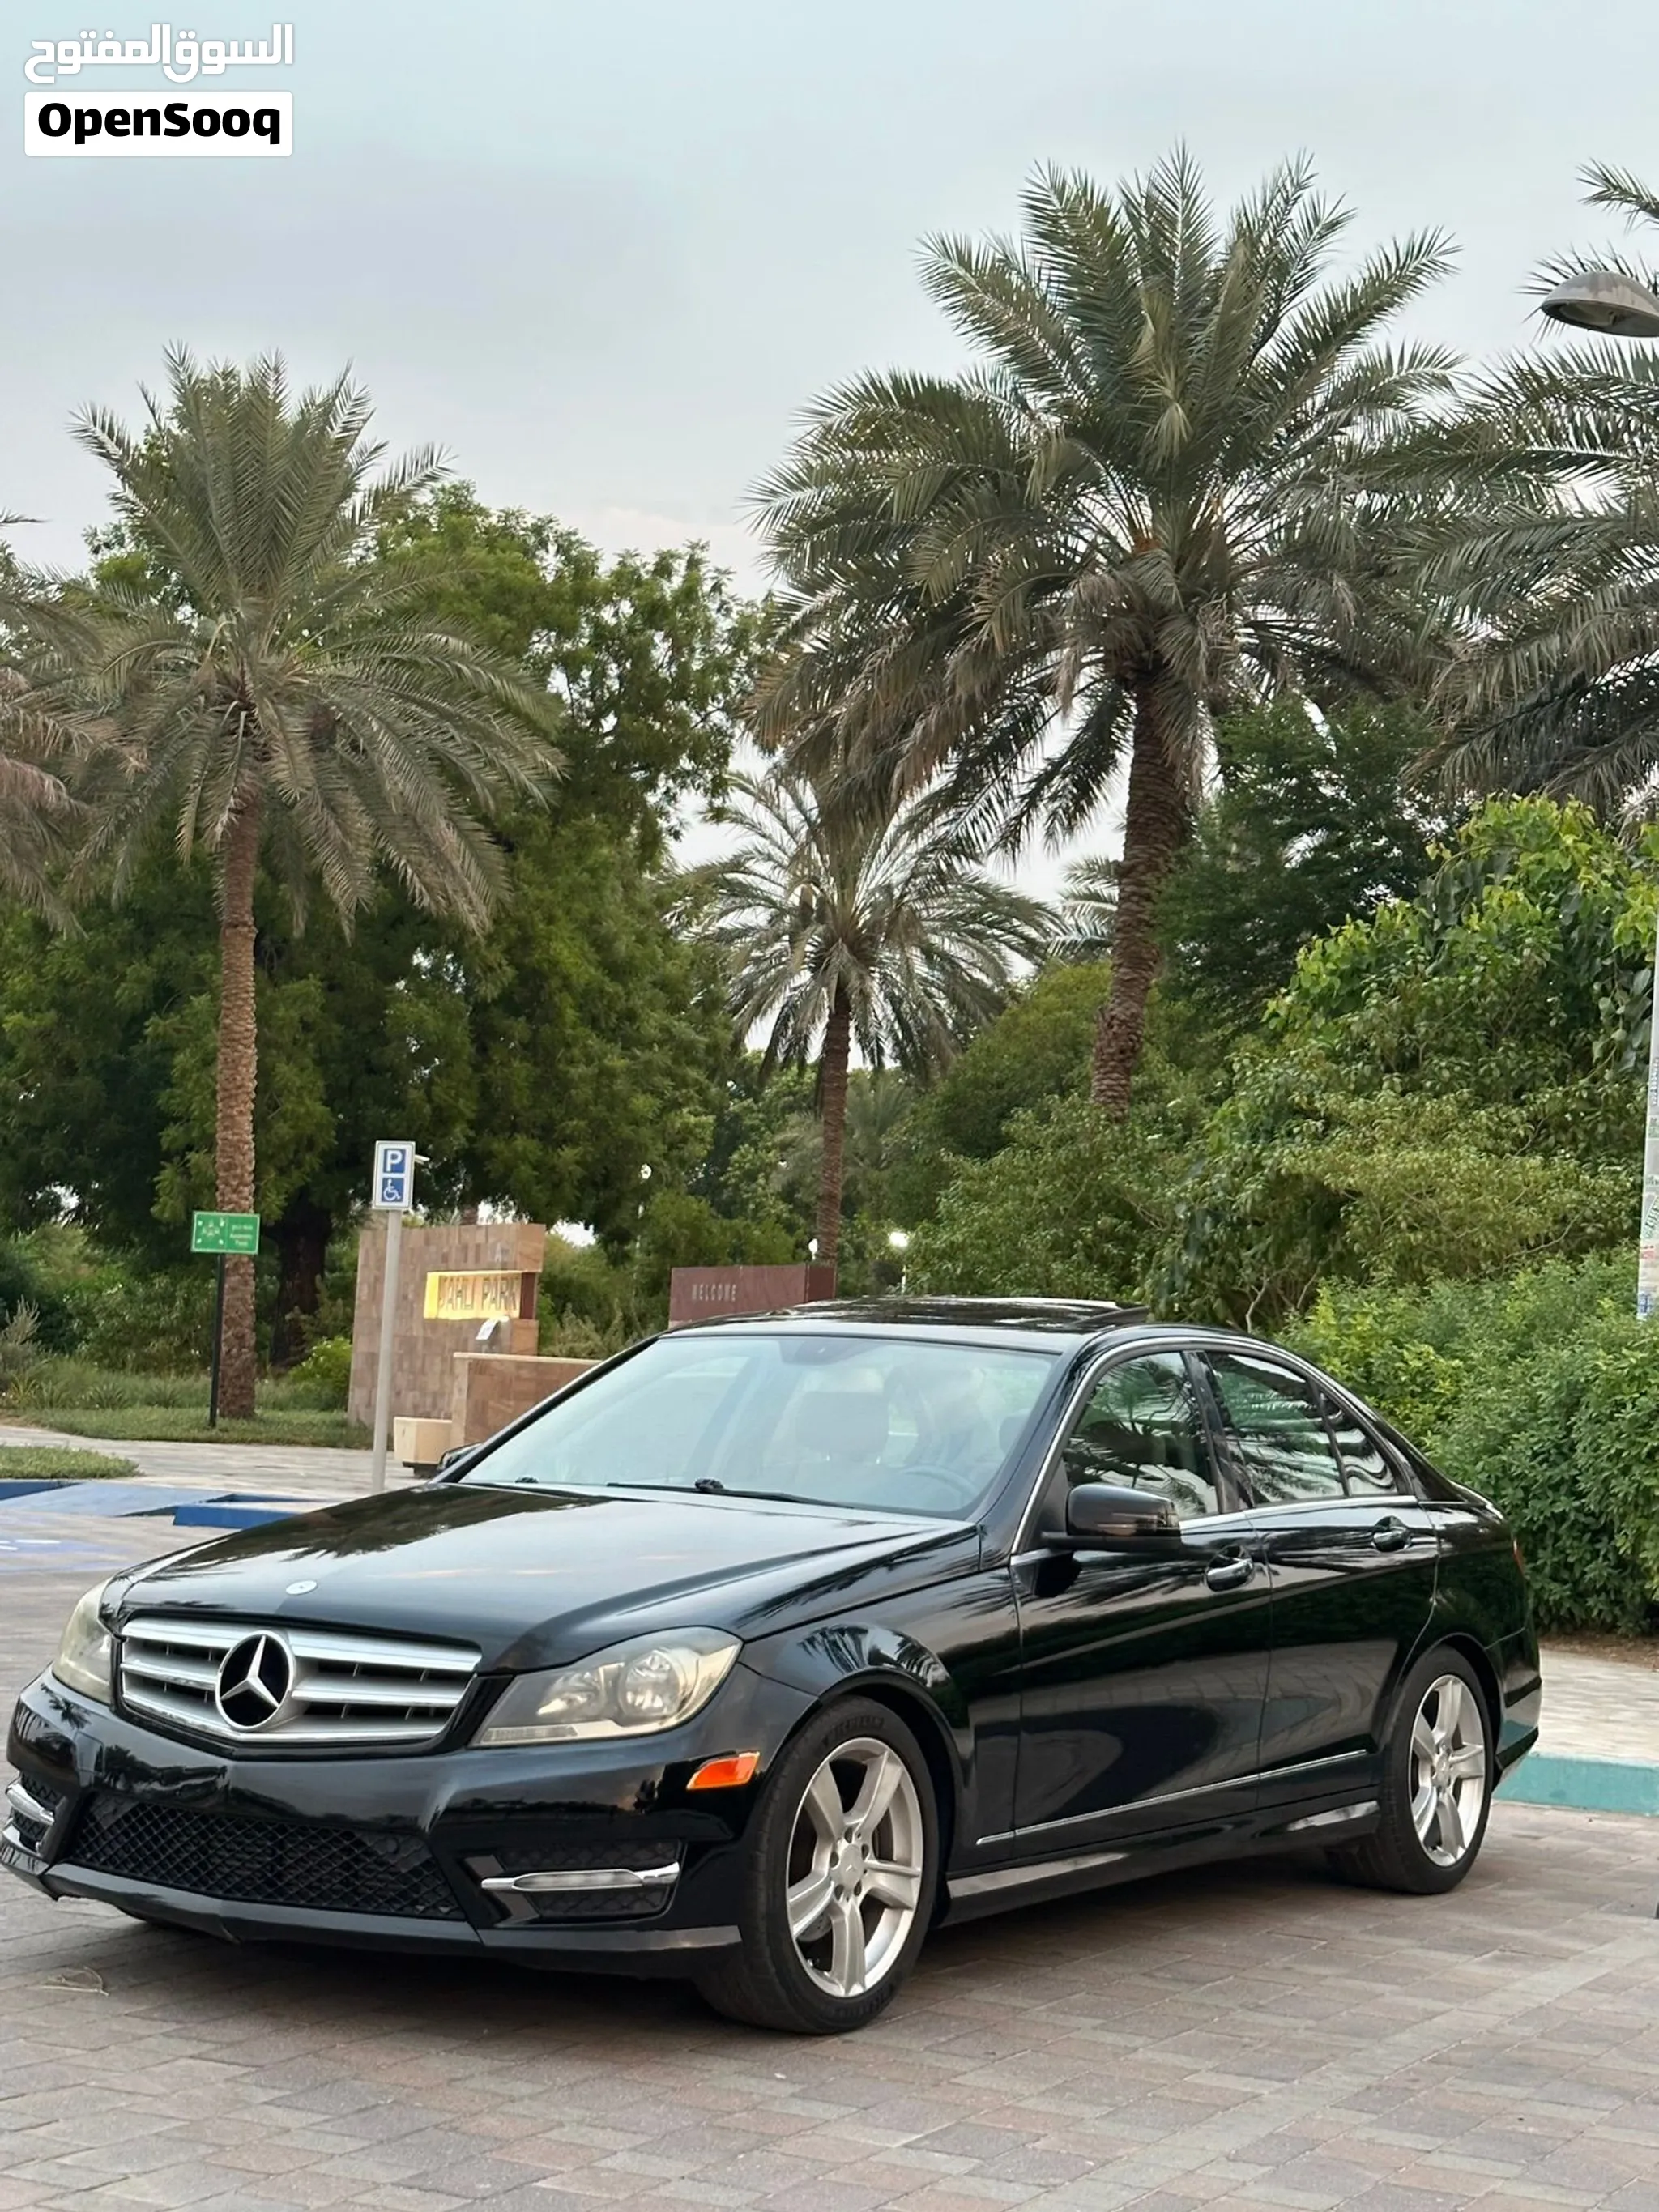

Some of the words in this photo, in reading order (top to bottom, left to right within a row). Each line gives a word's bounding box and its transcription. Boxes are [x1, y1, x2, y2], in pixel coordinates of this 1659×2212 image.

[386, 1150, 403, 1172] P
[481, 1276, 519, 1311] PARK
[692, 1284, 736, 1302] WELCOME
